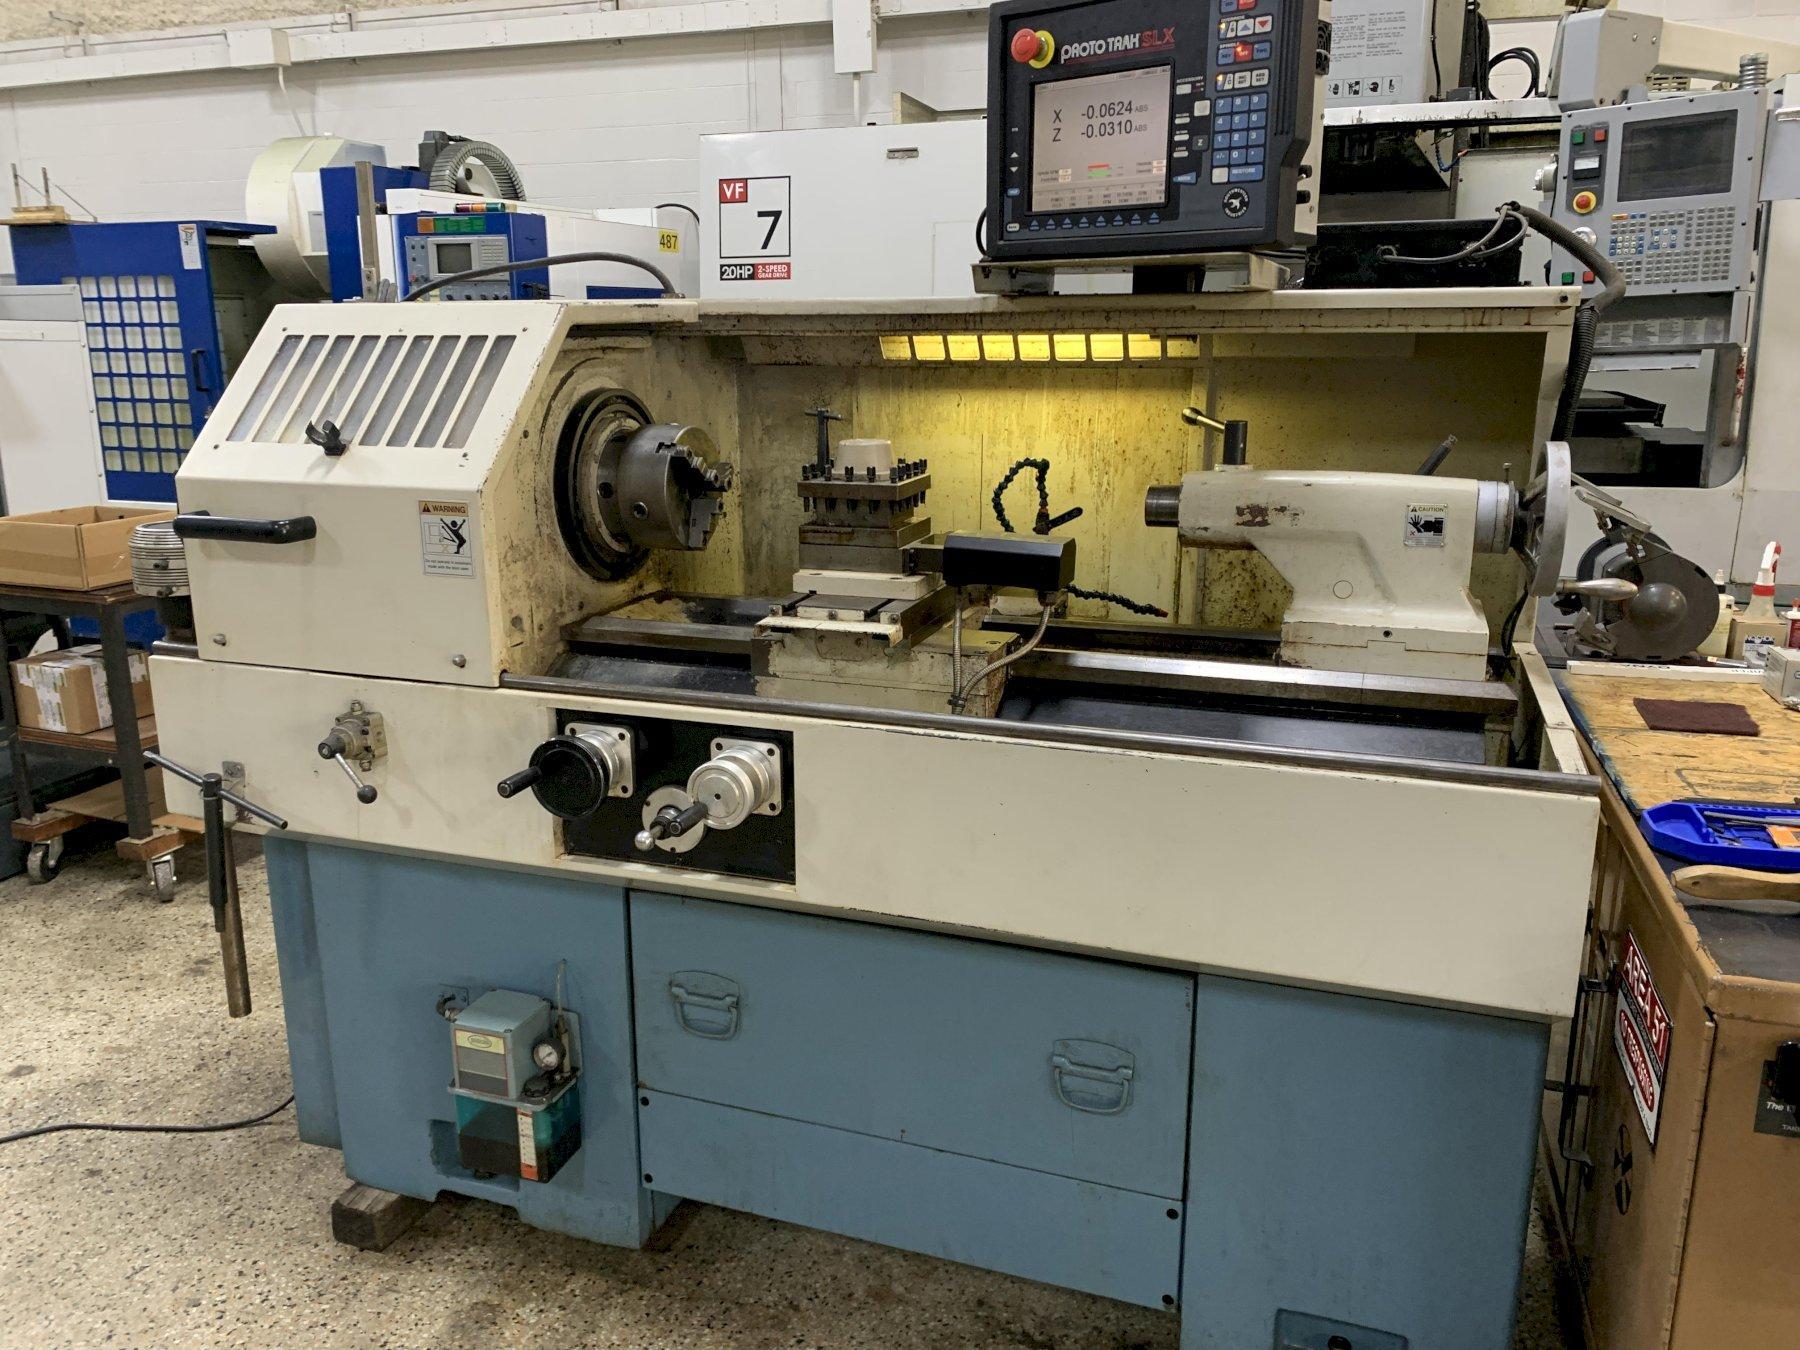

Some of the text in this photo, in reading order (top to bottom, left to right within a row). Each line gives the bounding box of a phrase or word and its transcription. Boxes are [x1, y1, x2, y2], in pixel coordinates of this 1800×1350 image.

[1141, 26, 1175, 46] SLX
[1053, 101, 1149, 123] X -0.0624 ABS
[1052, 120, 1148, 142] Z -0.0310 ABS
[723, 183, 744, 200] VF
[757, 210, 782, 250] 7
[659, 233, 678, 249] 487
[721, 265, 753, 279] 20HP
[758, 264, 788, 273] 2-SPEED
[432, 504, 466, 514] WARNING
[1624, 945, 1652, 1027] AREA
[1652, 1004, 1665, 1057] 51
